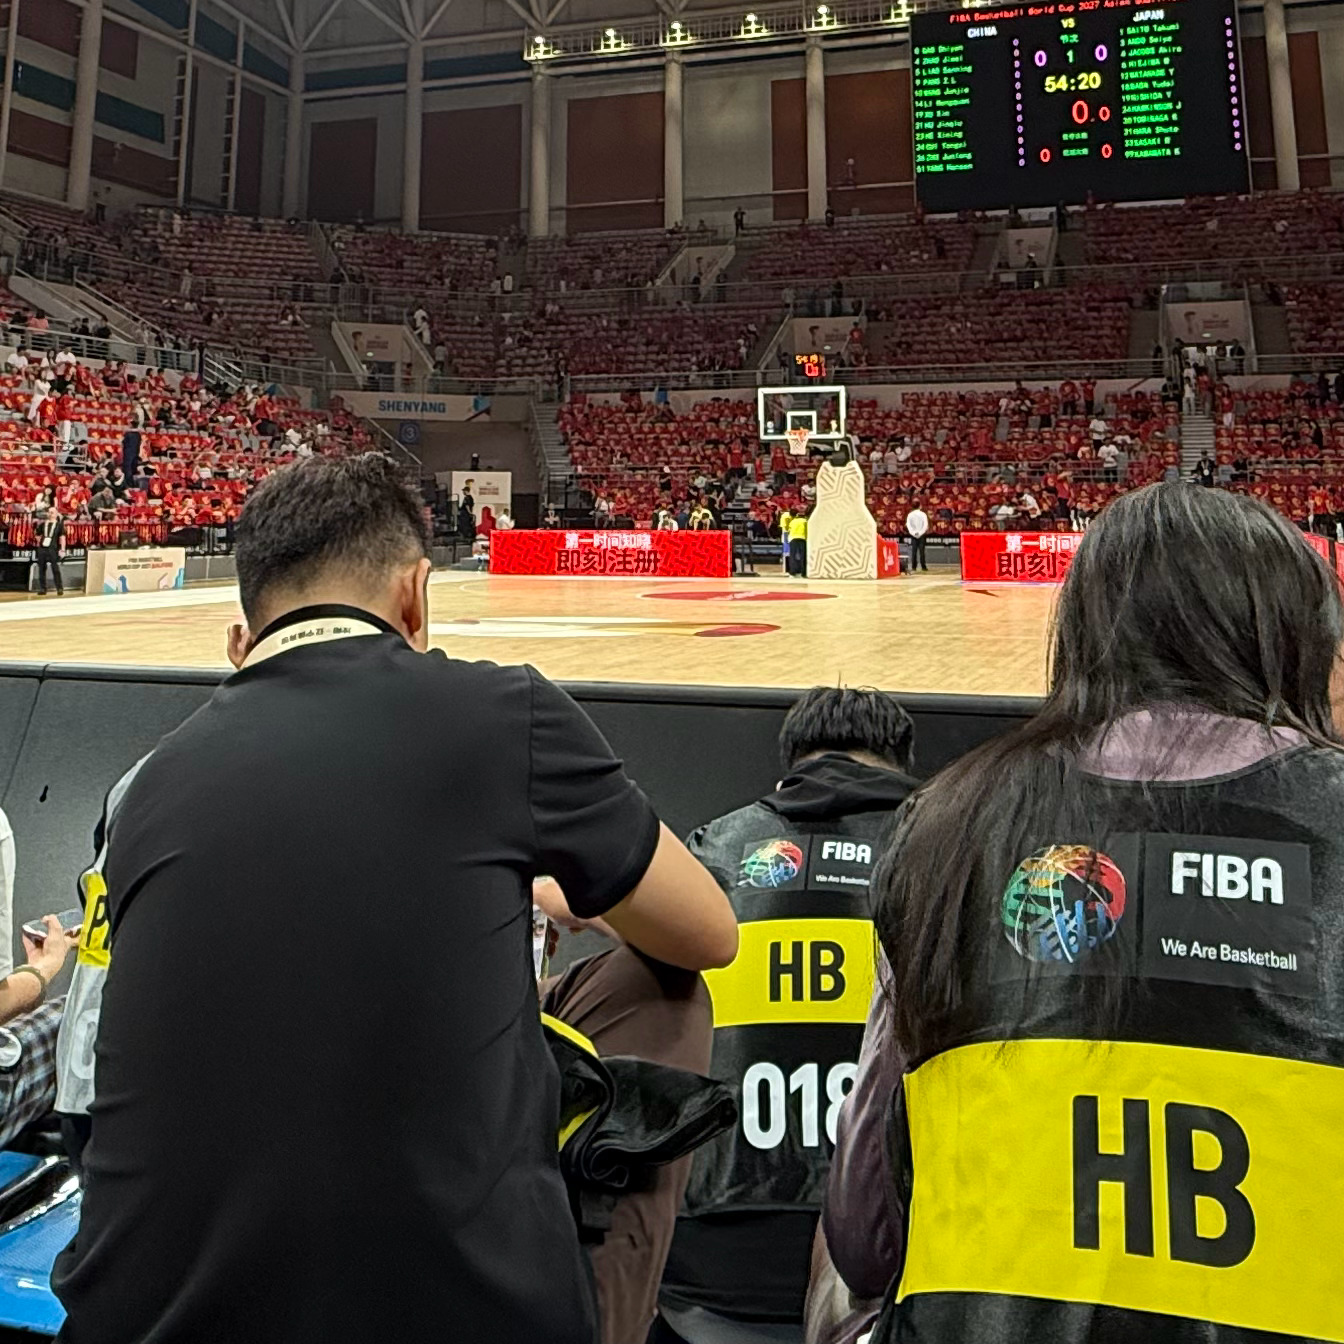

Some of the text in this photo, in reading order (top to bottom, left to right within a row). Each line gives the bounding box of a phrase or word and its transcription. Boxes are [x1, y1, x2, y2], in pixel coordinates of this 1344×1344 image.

[1058, 4, 1075, 13] Cup
[1078, 0, 1099, 11] 2027
[1061, 18, 1075, 28] VS
[1133, 9, 1164, 22] JAPAN
[967, 26, 998, 38] CHINA
[1035, 50, 1047, 67] 0
[1066, 49, 1074, 63] 1
[1095, 44, 1108, 61] 0
[1044, 72, 1102, 92] 54:20
[379, 400, 446, 413] SHENYANG
[1006, 535, 1080, 553] 第一时间
[556, 549, 660, 573] 即刻注册
[822, 841, 872, 864] FIBA
[1172, 852, 1284, 905] FIBA
[1161, 937, 1298, 971] We Are Basketball
[769, 941, 846, 1002] HB
[1071, 1094, 1255, 1268] HB
